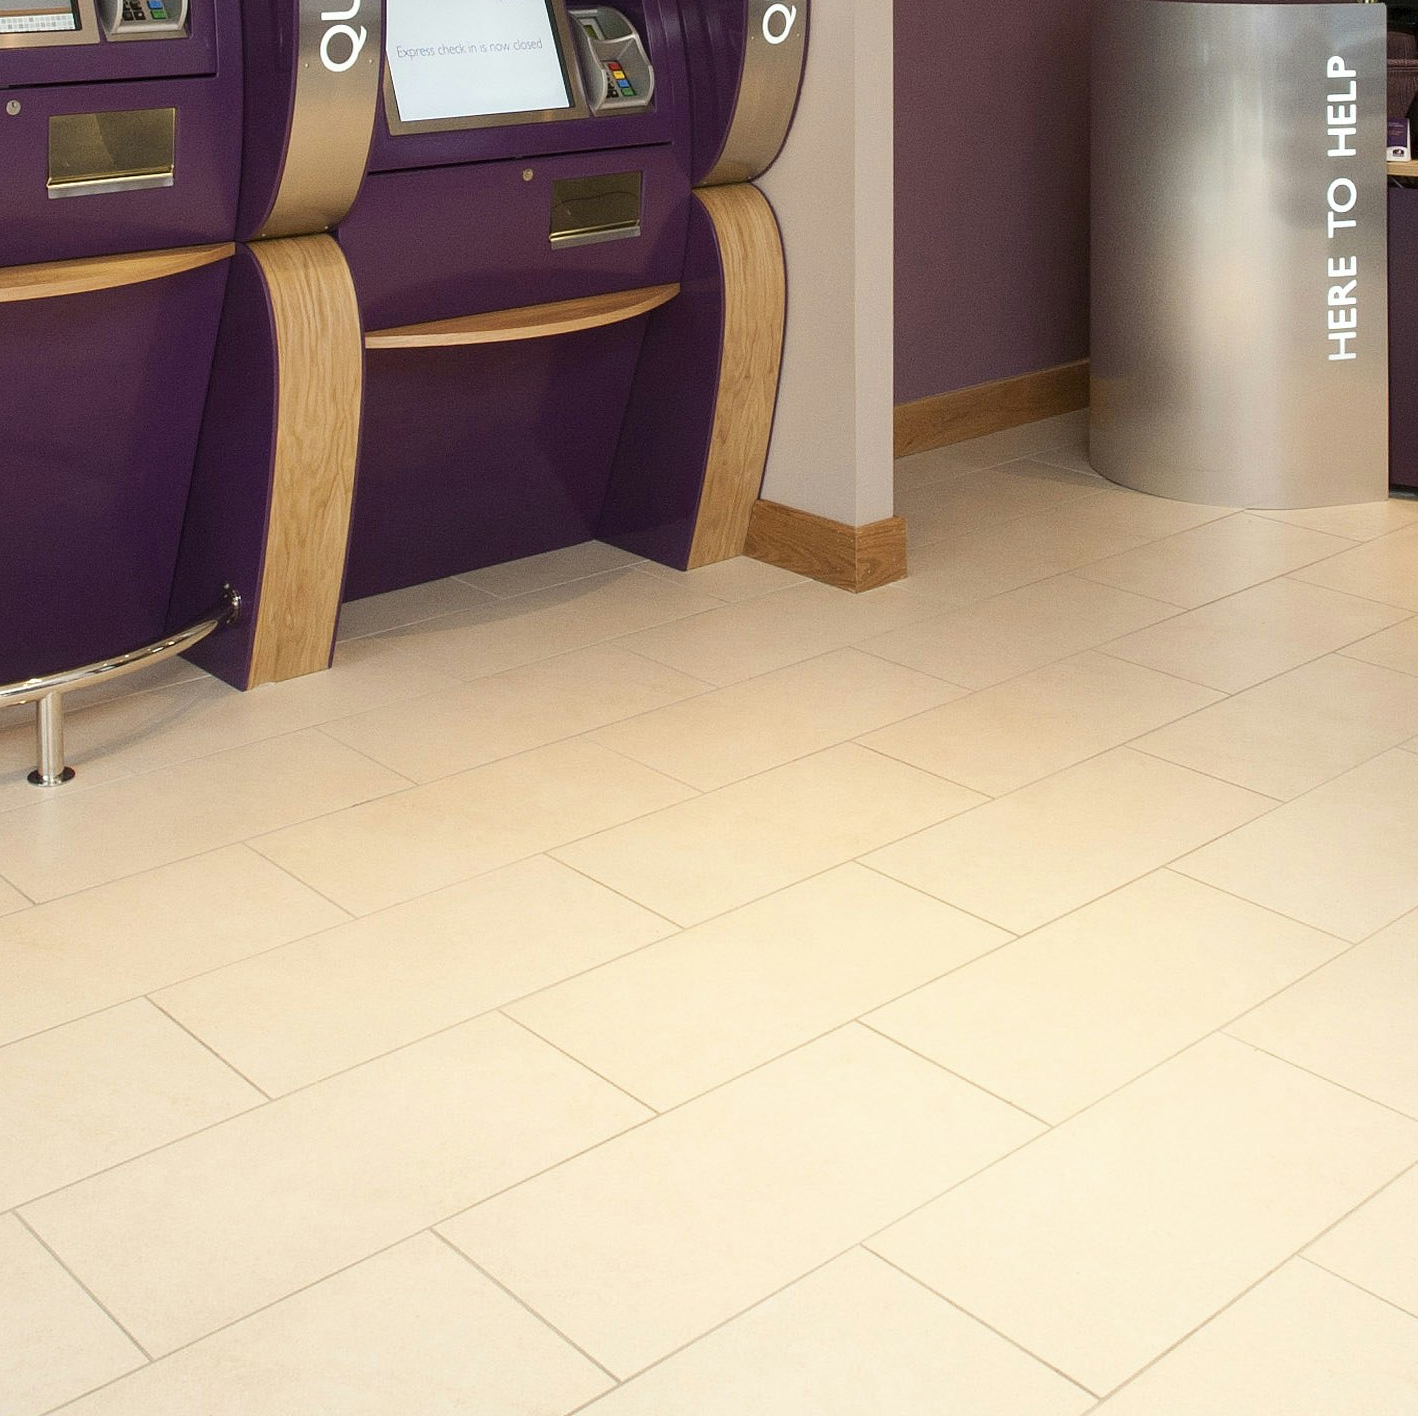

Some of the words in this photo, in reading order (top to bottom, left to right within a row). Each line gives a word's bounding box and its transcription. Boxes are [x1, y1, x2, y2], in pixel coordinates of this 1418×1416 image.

[396, 45, 435, 60] Express
[438, 40, 466, 55] check
[468, 43, 478, 54] in
[480, 42, 487, 53] is
[489, 42, 511, 52] now
[513, 38, 543, 51] closed
[1327, 55, 1357, 157] HELP
[1327, 177, 1357, 239] TO
[1327, 255, 1357, 361] HERE
